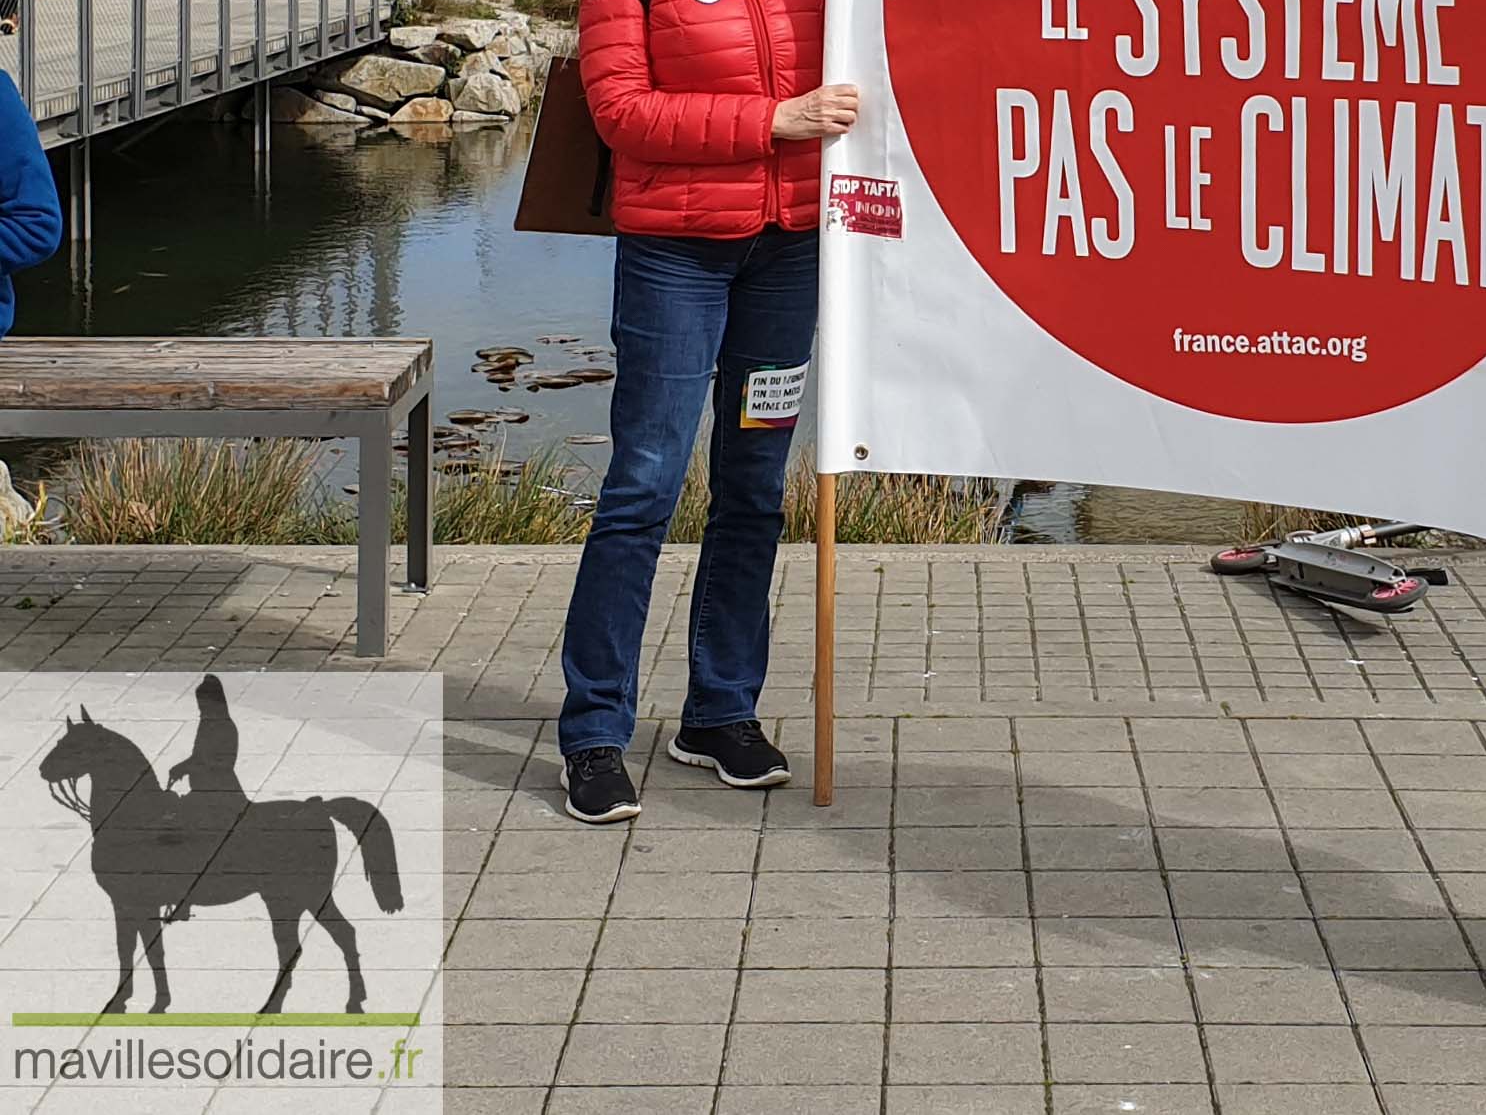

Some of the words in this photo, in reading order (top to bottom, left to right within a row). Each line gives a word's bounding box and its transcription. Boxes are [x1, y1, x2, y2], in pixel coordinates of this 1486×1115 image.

[995, 88, 1135, 259] PAS
[1164, 125, 1212, 231] LE
[1172, 327, 1368, 362] france.attac.org
